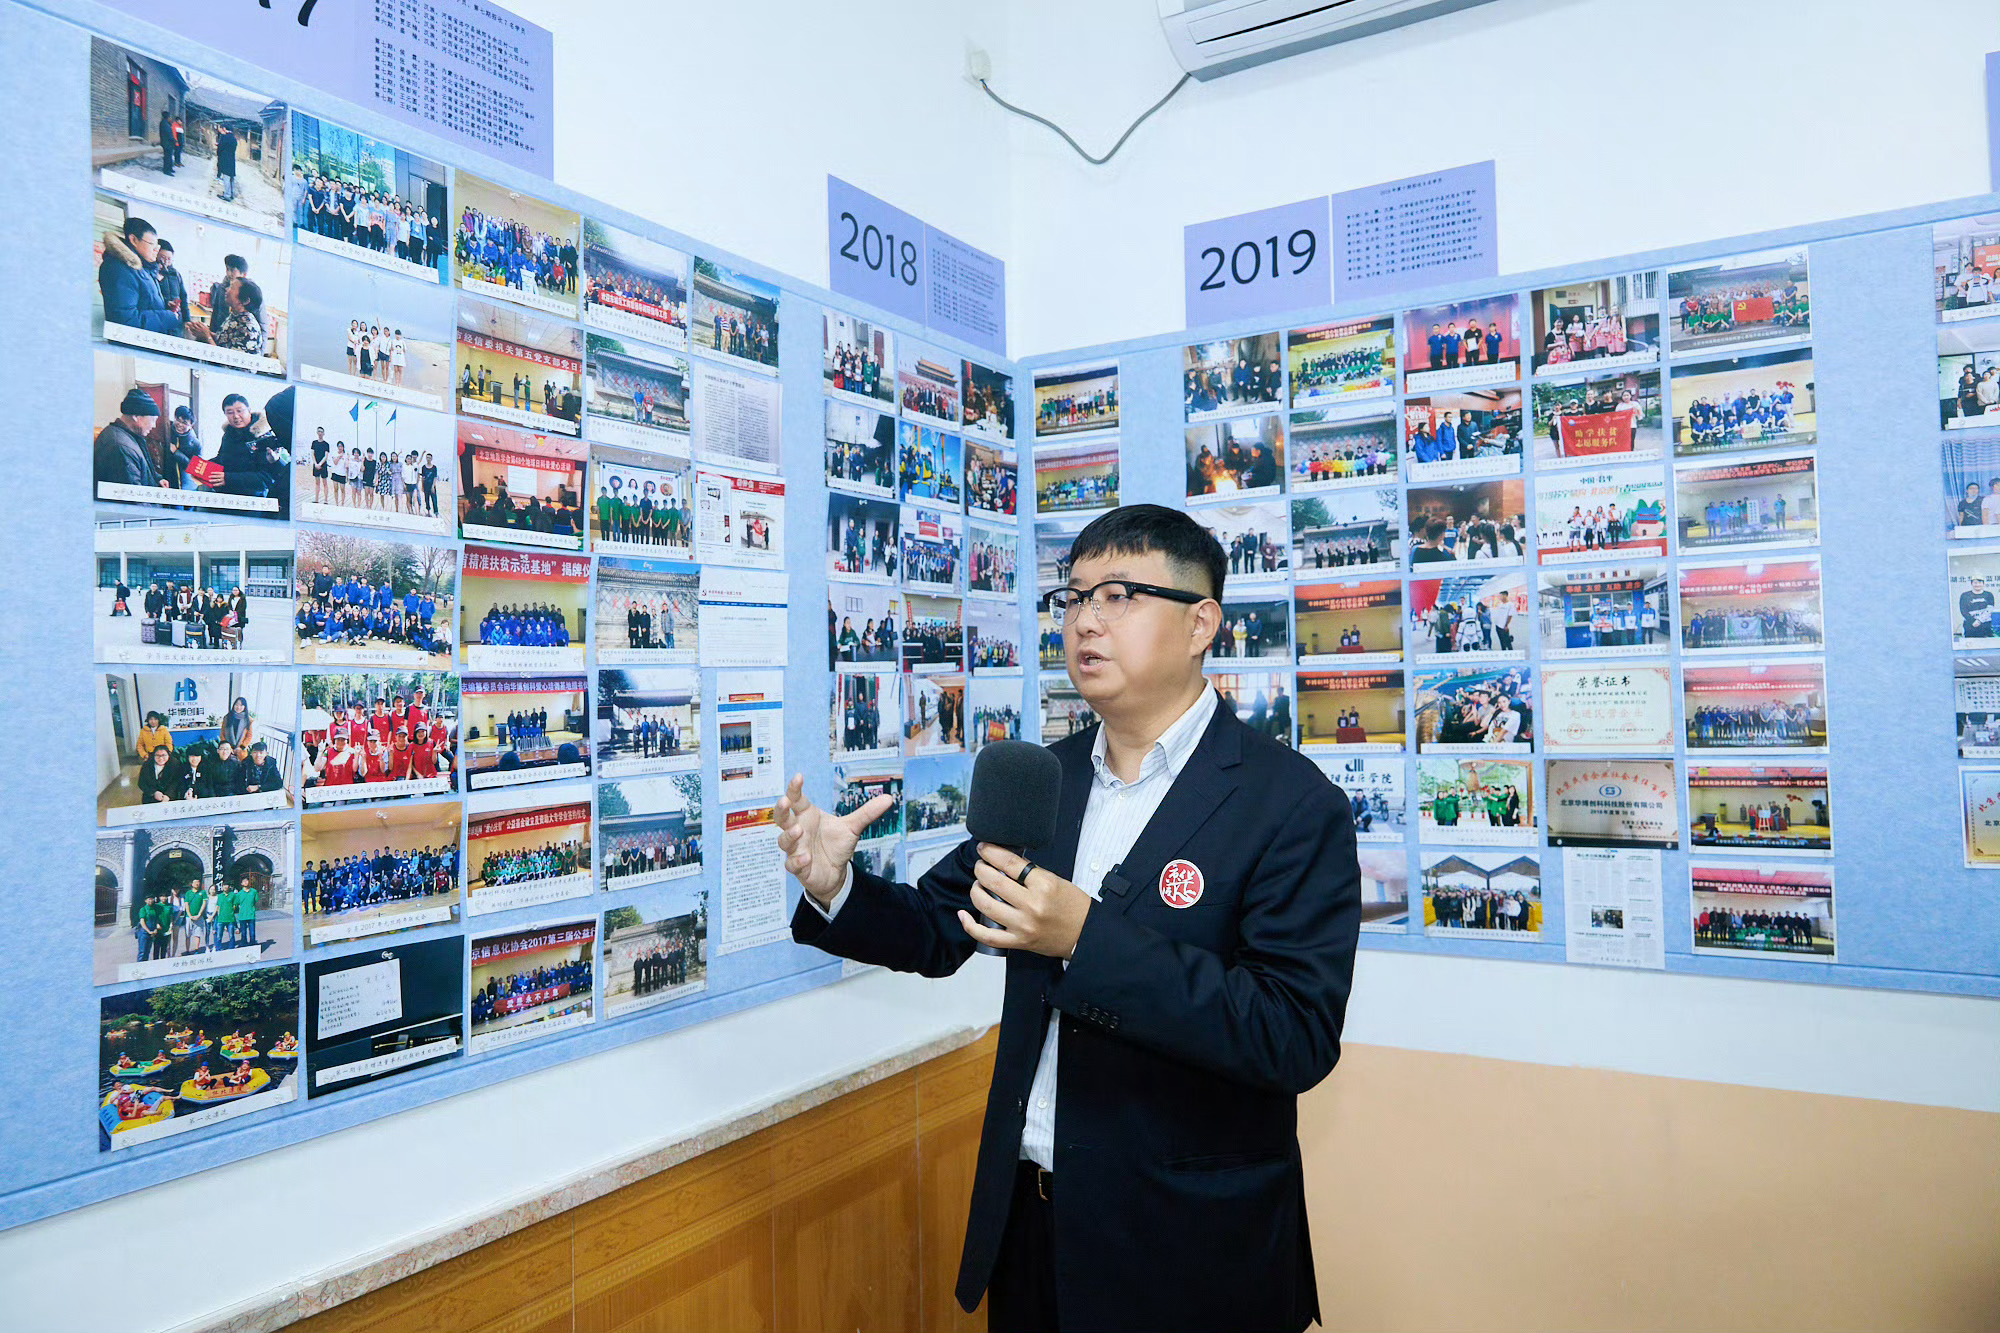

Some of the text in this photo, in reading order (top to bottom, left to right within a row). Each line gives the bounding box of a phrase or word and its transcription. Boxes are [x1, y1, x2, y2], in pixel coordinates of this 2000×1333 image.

[840, 211, 917, 286] 2018
[1200, 229, 1316, 291] 2019
[457, 331, 582, 373] 市经信委机关第五党支部党日
[1577, 675, 1631, 689] 荣誉证书
